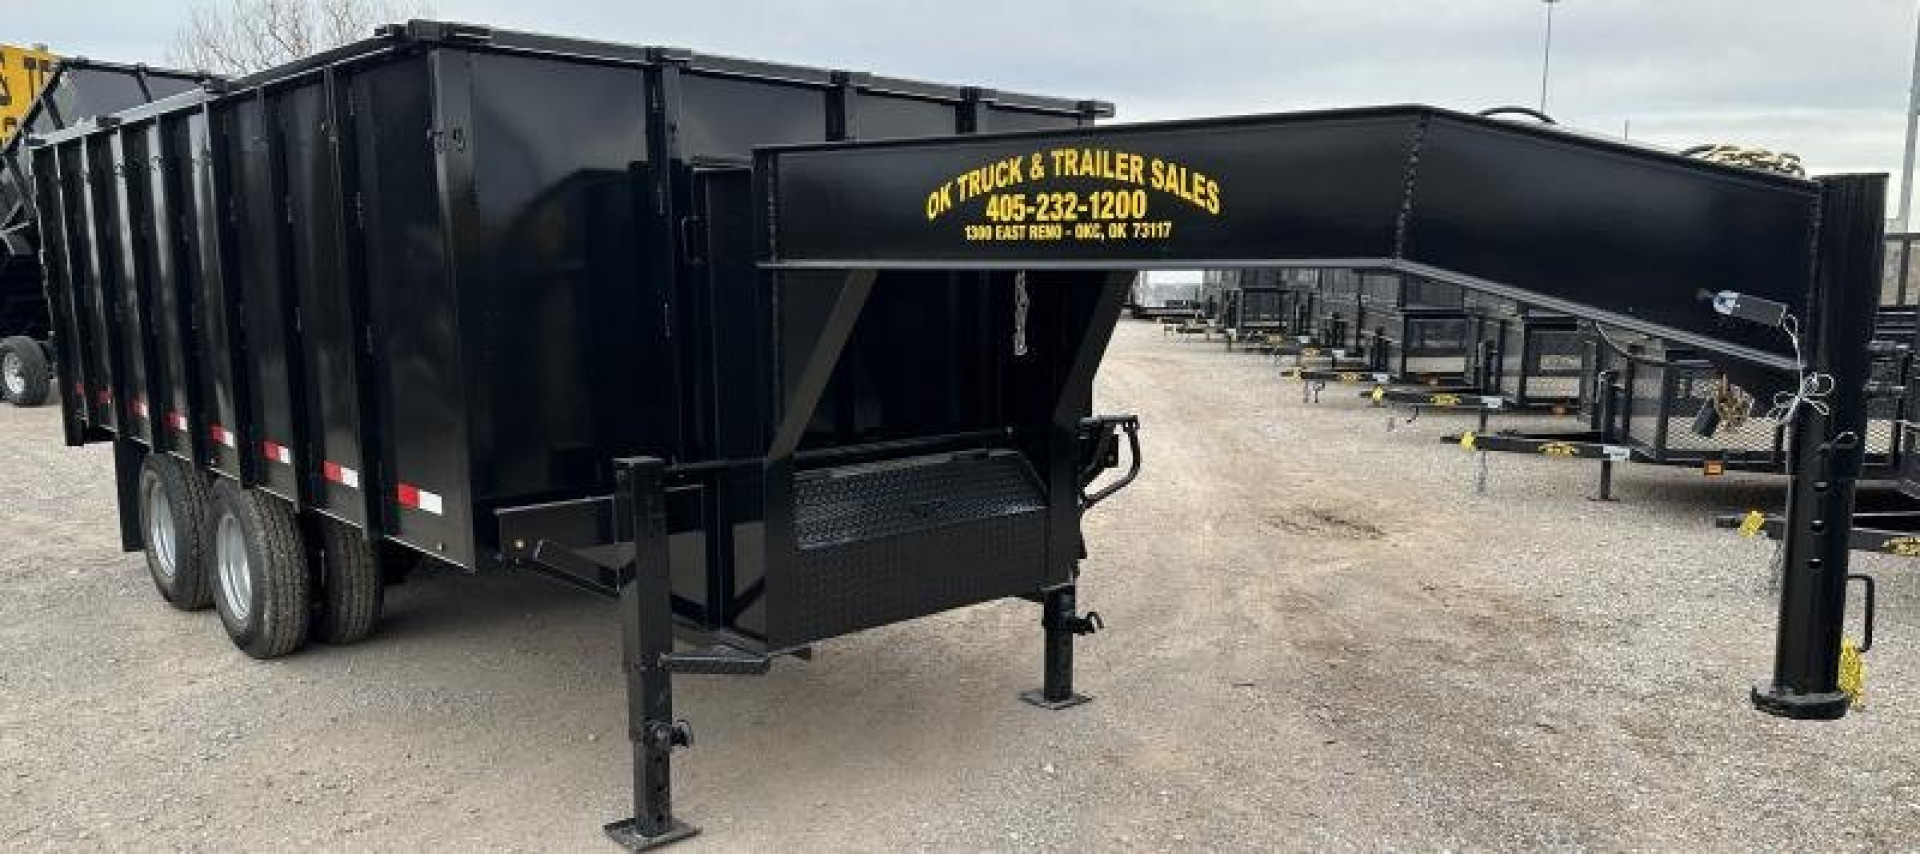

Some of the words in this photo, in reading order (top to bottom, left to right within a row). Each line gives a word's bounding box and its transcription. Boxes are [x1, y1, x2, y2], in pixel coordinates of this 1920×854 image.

[926, 181, 952, 220] OK
[957, 155, 1023, 202] TRUCK
[1029, 152, 1045, 181] &
[1050, 148, 1144, 185] TRAILER
[1151, 158, 1220, 215] SALES
[985, 190, 1147, 221] 405-232-1200
[964, 224, 992, 241] 1300
[995, 224, 1026, 241] EAST
[1029, 224, 1062, 240] RENO
[1074, 223, 1105, 241] OKC,
[1108, 222, 1127, 239] OK
[1132, 220, 1172, 239] 73117
